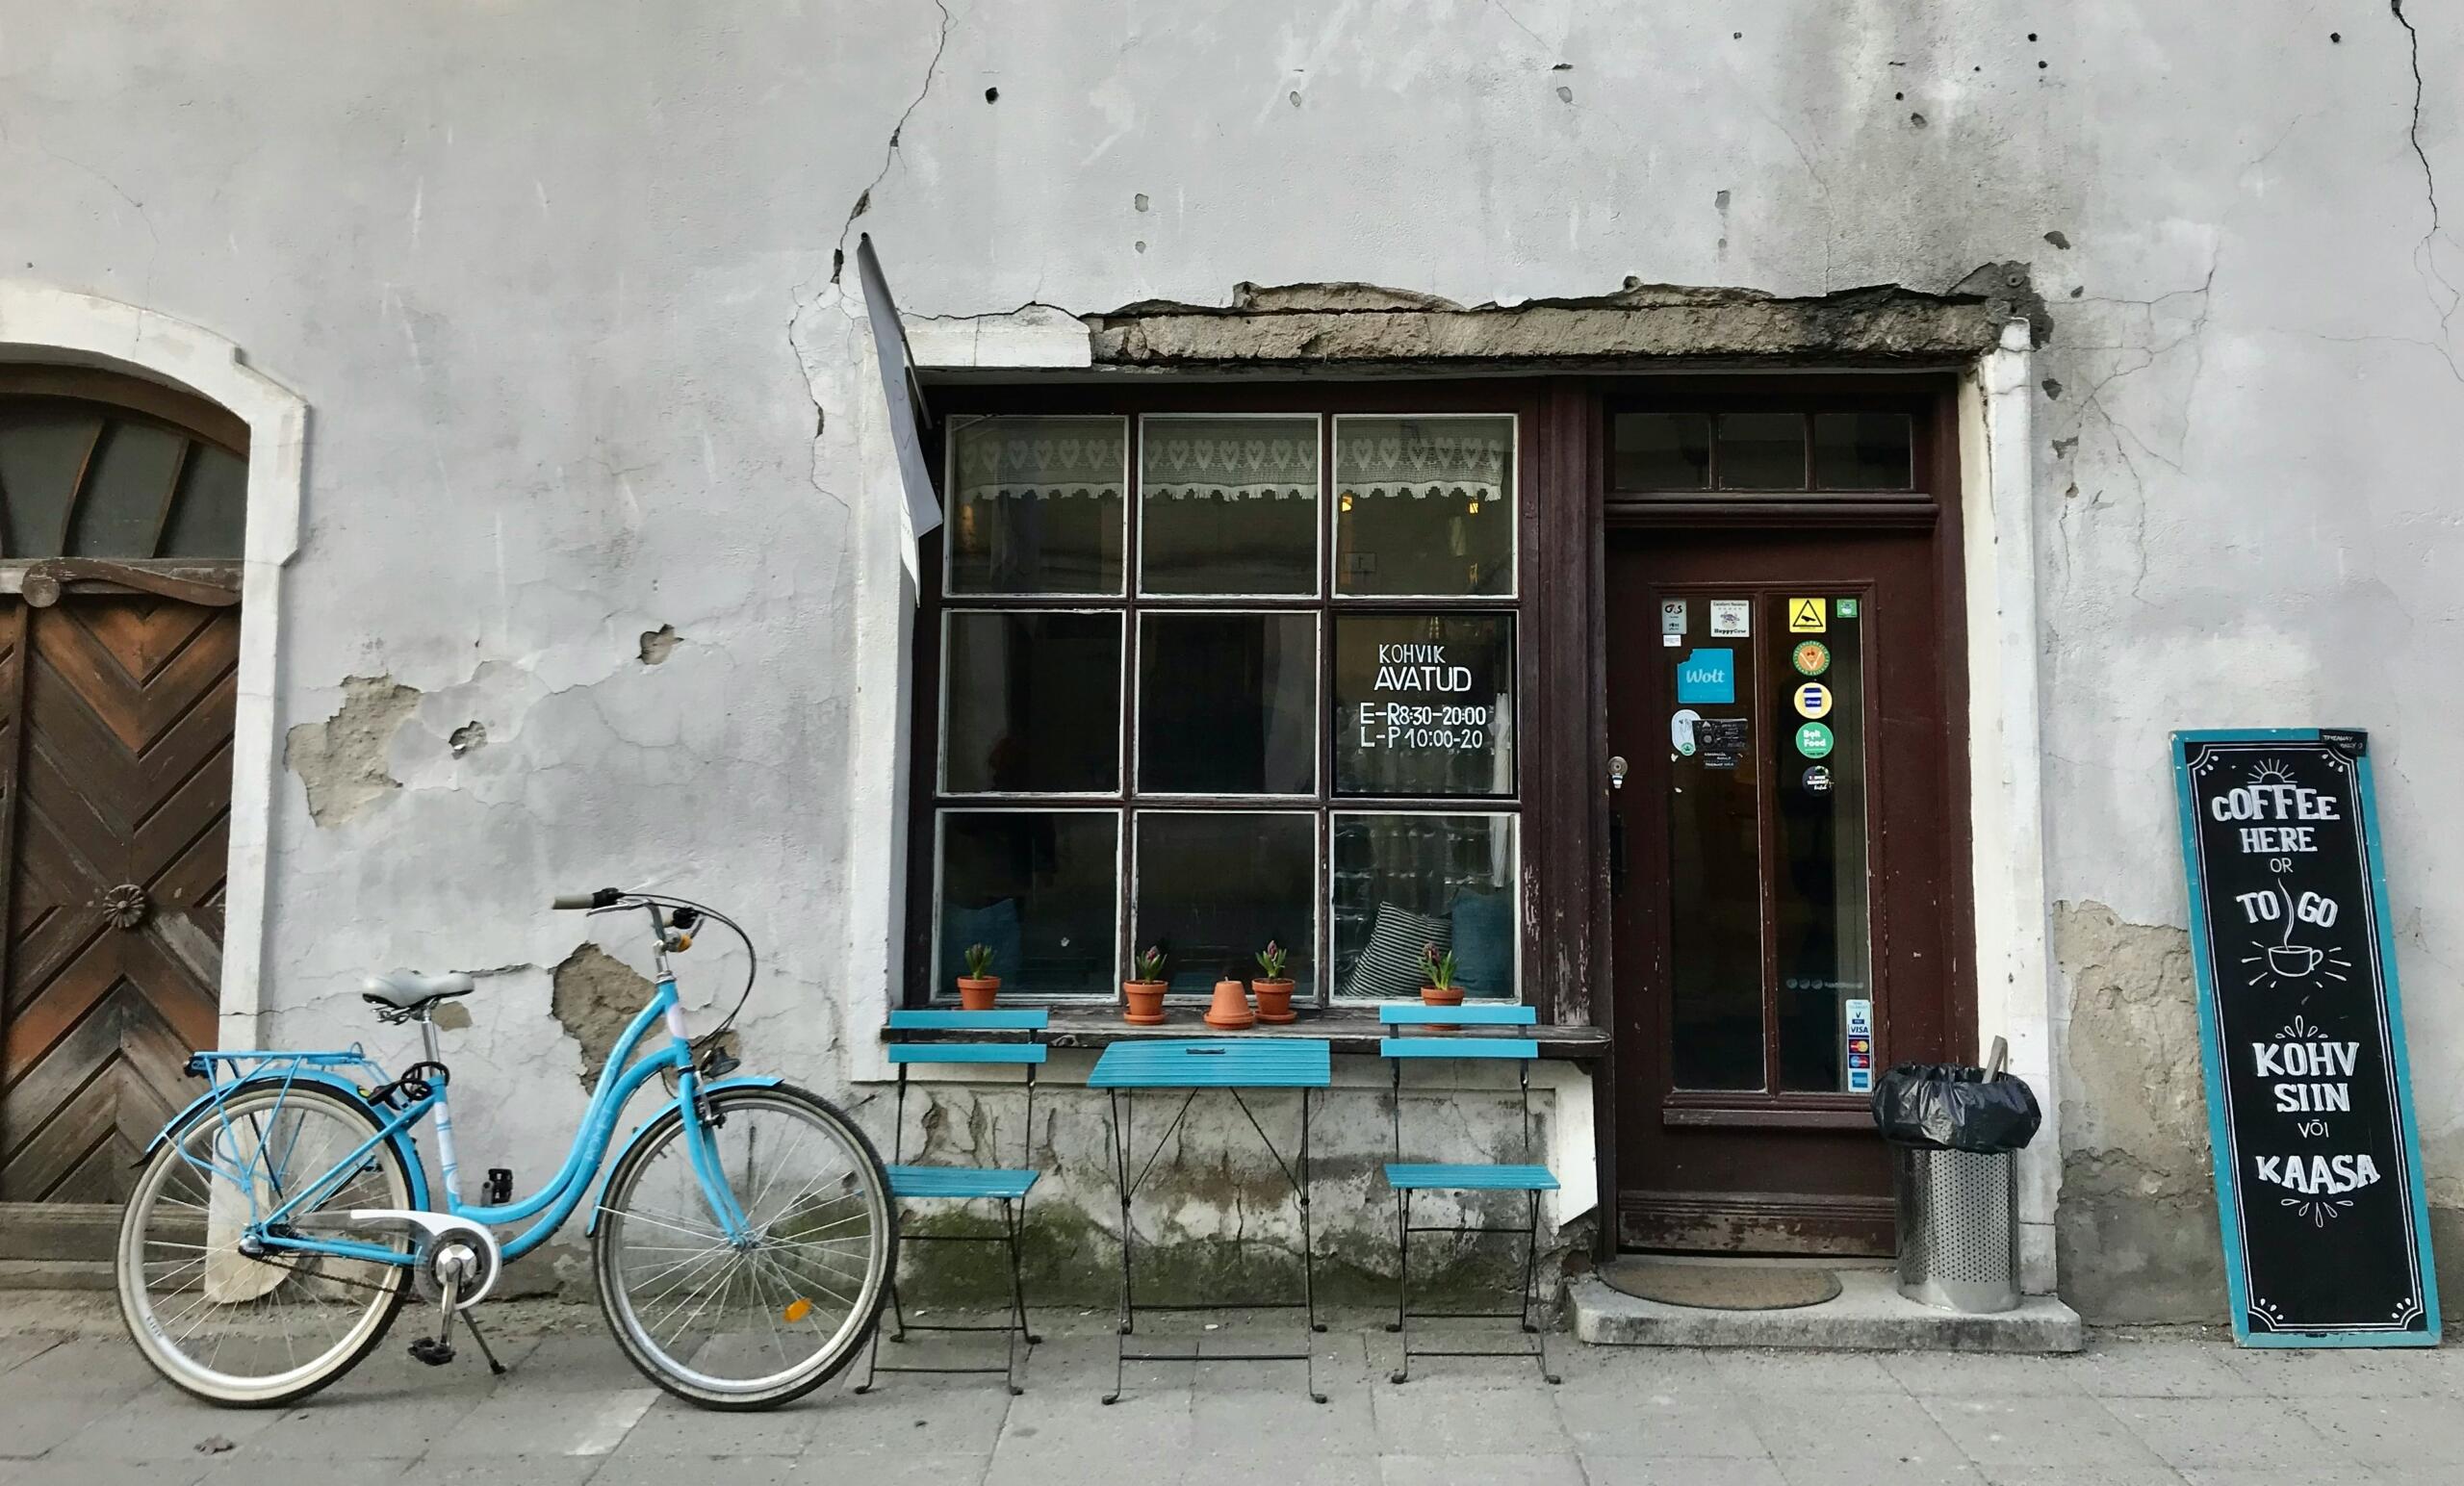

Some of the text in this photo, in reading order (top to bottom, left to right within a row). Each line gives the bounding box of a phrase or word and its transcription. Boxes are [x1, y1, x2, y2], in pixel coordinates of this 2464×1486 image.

[1378, 644, 1447, 664] KOHVIK
[1373, 666, 1473, 692] AVATUD
[1686, 668, 1726, 683] Wolt
[1403, 728, 1483, 749] 10:00-20
[1803, 730, 1821, 740] Bolt
[1803, 738, 1827, 748] Food
[2211, 783, 2341, 822] COFFEE
[2239, 827, 2319, 854] HERE
[2270, 858, 2294, 873] OR
[2236, 890, 2339, 928] TO GO
[2252, 1041, 2360, 1077] KOHV
[2273, 1082, 2351, 1113] SIIN
[2255, 1154, 2382, 1195] KAASA
